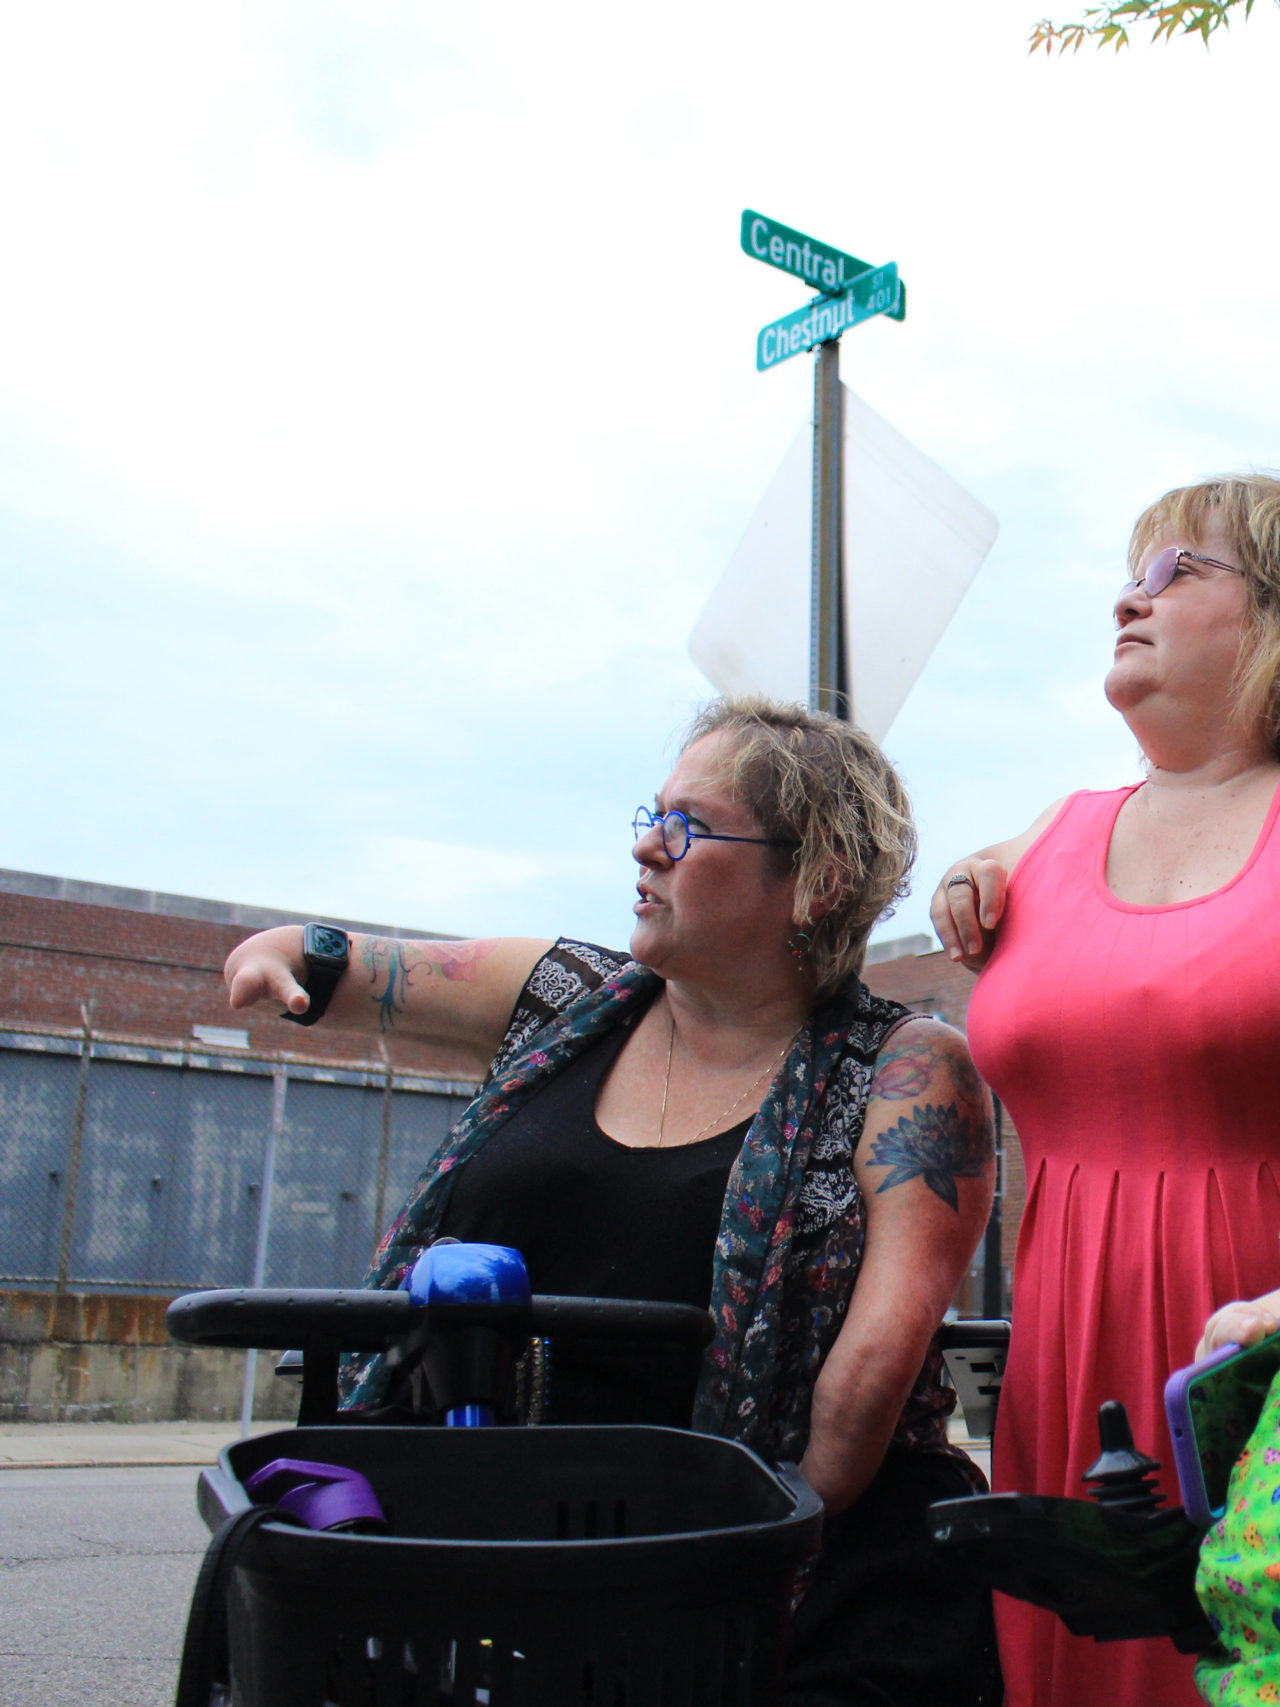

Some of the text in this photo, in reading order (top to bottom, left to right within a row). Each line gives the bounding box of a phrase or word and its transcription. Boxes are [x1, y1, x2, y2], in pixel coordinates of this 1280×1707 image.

[751, 219, 844, 290] Central
[762, 289, 855, 365] Chestnut
[866, 286, 891, 310] 401
